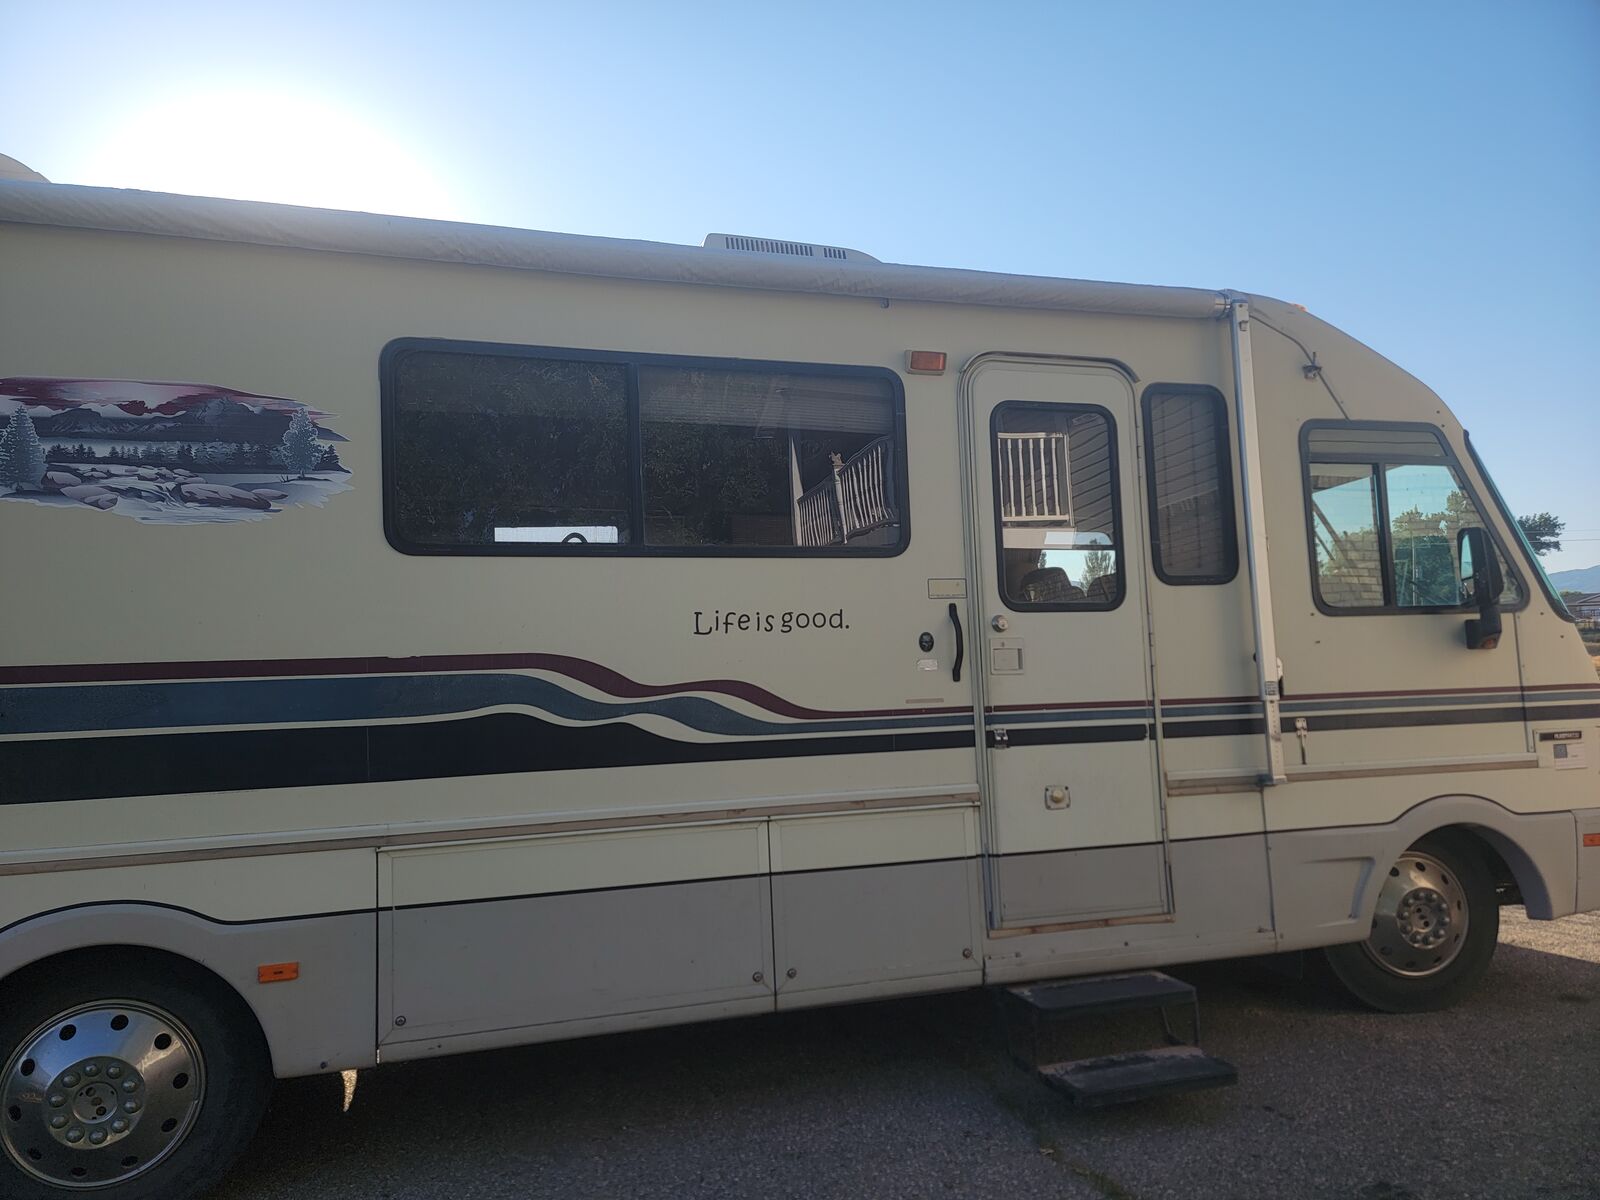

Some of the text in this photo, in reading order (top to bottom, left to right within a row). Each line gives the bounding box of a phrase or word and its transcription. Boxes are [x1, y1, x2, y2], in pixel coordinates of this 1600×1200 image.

[693, 608, 850, 636] Life is good.
